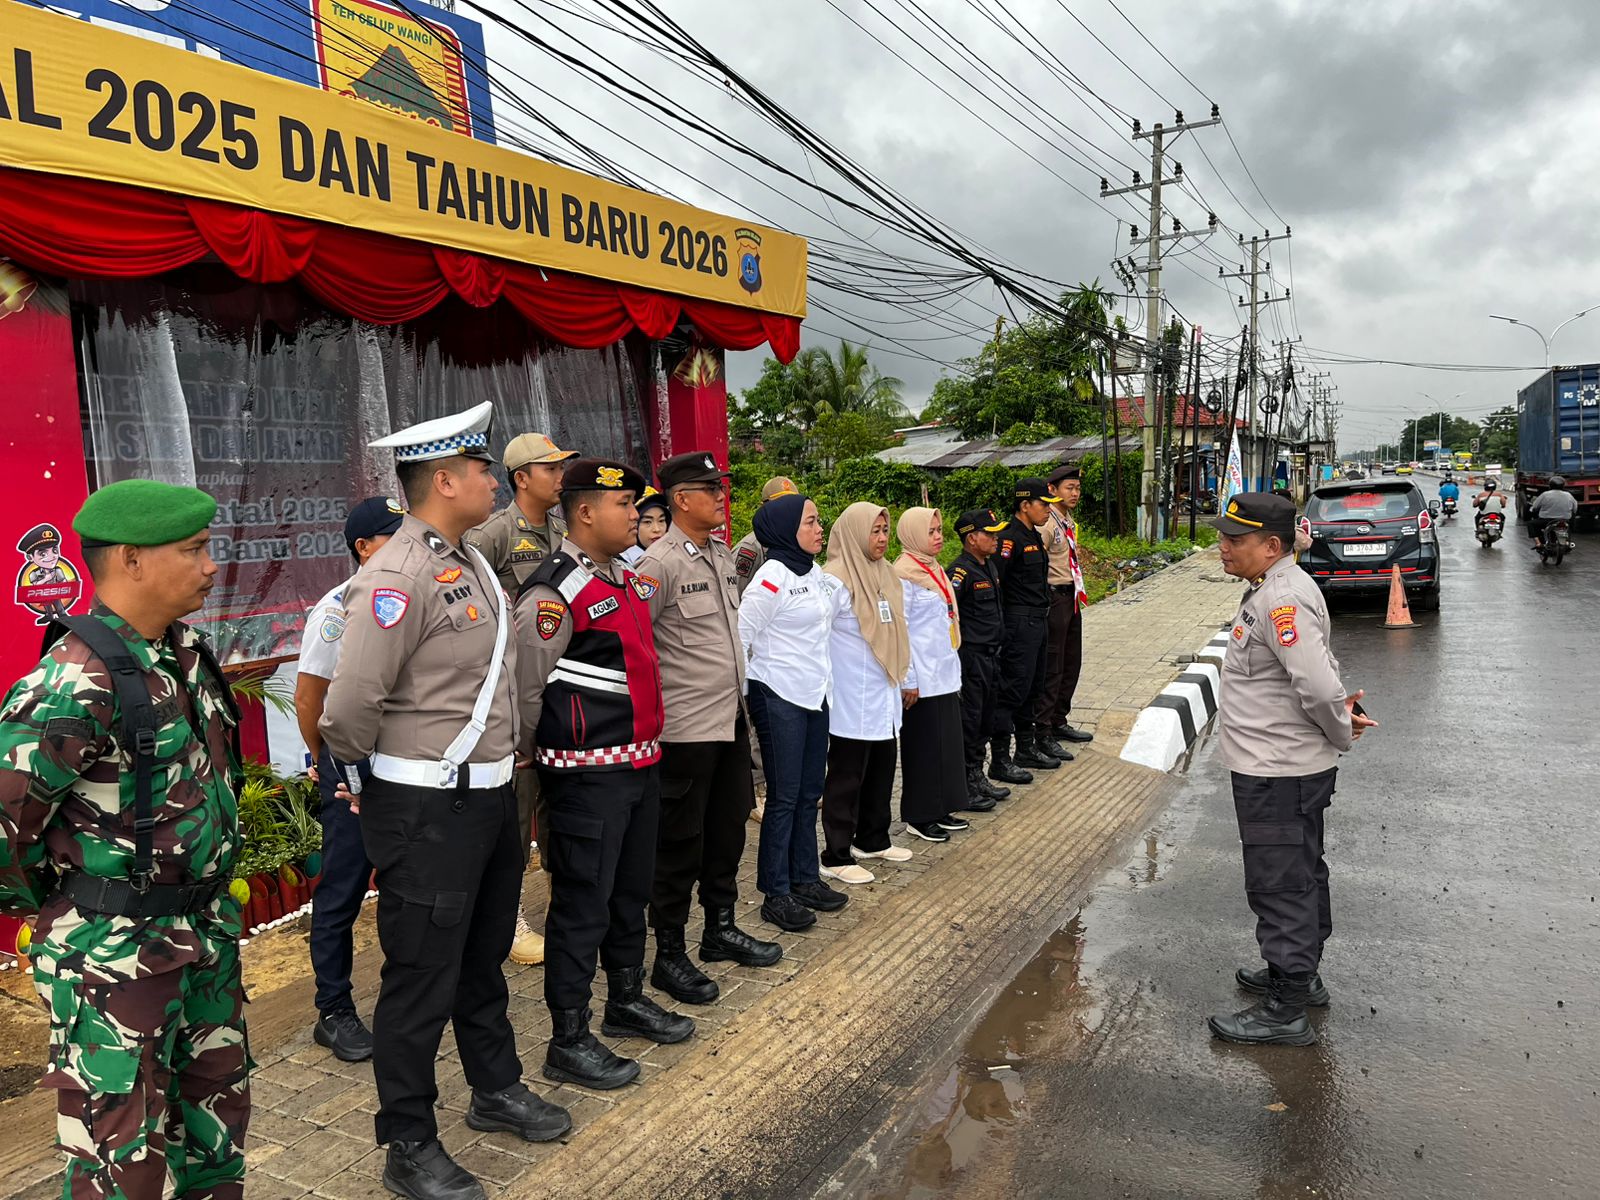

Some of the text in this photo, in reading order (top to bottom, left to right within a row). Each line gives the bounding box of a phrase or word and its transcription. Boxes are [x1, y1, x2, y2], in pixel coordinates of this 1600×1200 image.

[332, 3, 433, 46] TEH CELUP WANGI
[0, 48, 62, 131] L
[85, 68, 259, 171] 2025
[279, 115, 391, 202] DAN
[406, 150, 550, 238] TAHUN
[561, 193, 650, 259] BARU
[658, 220, 728, 278] 2026
[210, 497, 350, 527] atal 2025
[209, 531, 349, 564] Baru 202
[514, 551, 540, 561] DAVID
[27, 586, 72, 598] PRESISI
[592, 598, 617, 617] AGUNG
